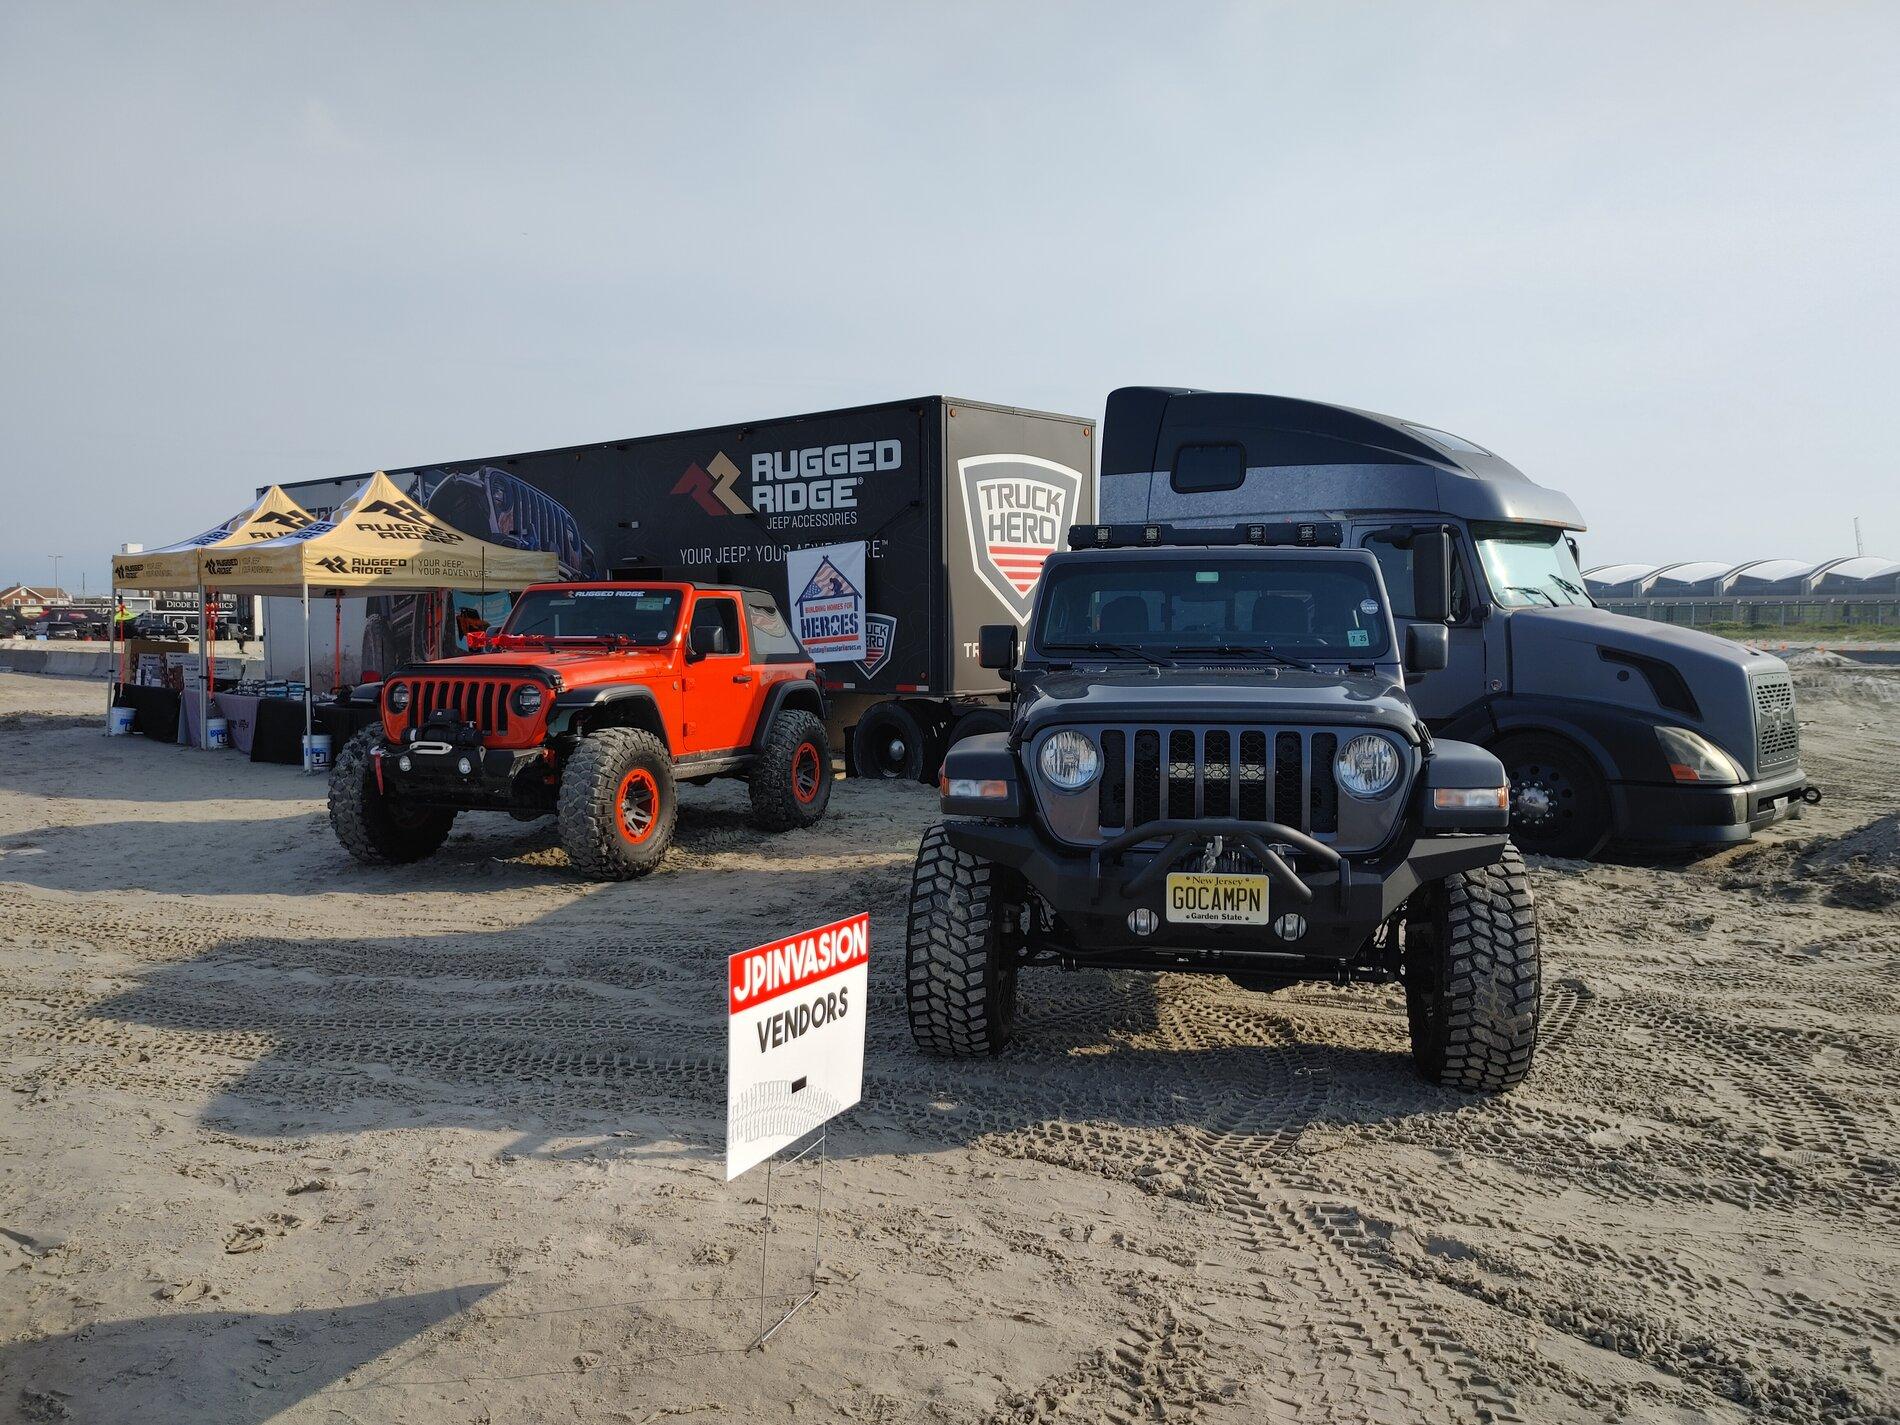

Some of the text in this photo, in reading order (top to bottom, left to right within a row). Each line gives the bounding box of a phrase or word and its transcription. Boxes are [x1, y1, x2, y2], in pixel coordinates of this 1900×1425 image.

[751, 439, 902, 482] RUGGED
[980, 483, 1063, 517] TRUCK
[791, 511, 858, 528] ACCESSORIES
[988, 511, 1056, 544] HERO
[355, 523, 464, 542] RUGGED
[379, 532, 458, 546] RIDGE
[351, 557, 407, 567] RUGGED
[418, 559, 440, 567] YOUR
[679, 547, 712, 565] YOUR
[418, 567, 441, 577] YOUR
[800, 612, 859, 638] HEROES
[1192, 876, 1243, 886] New Jersey
[1172, 886, 1260, 912] GOCAMPN
[1191, 912, 1242, 921] Garden State
[733, 919, 868, 1002] JPINVASION
[756, 986, 849, 1054] VENDORS
